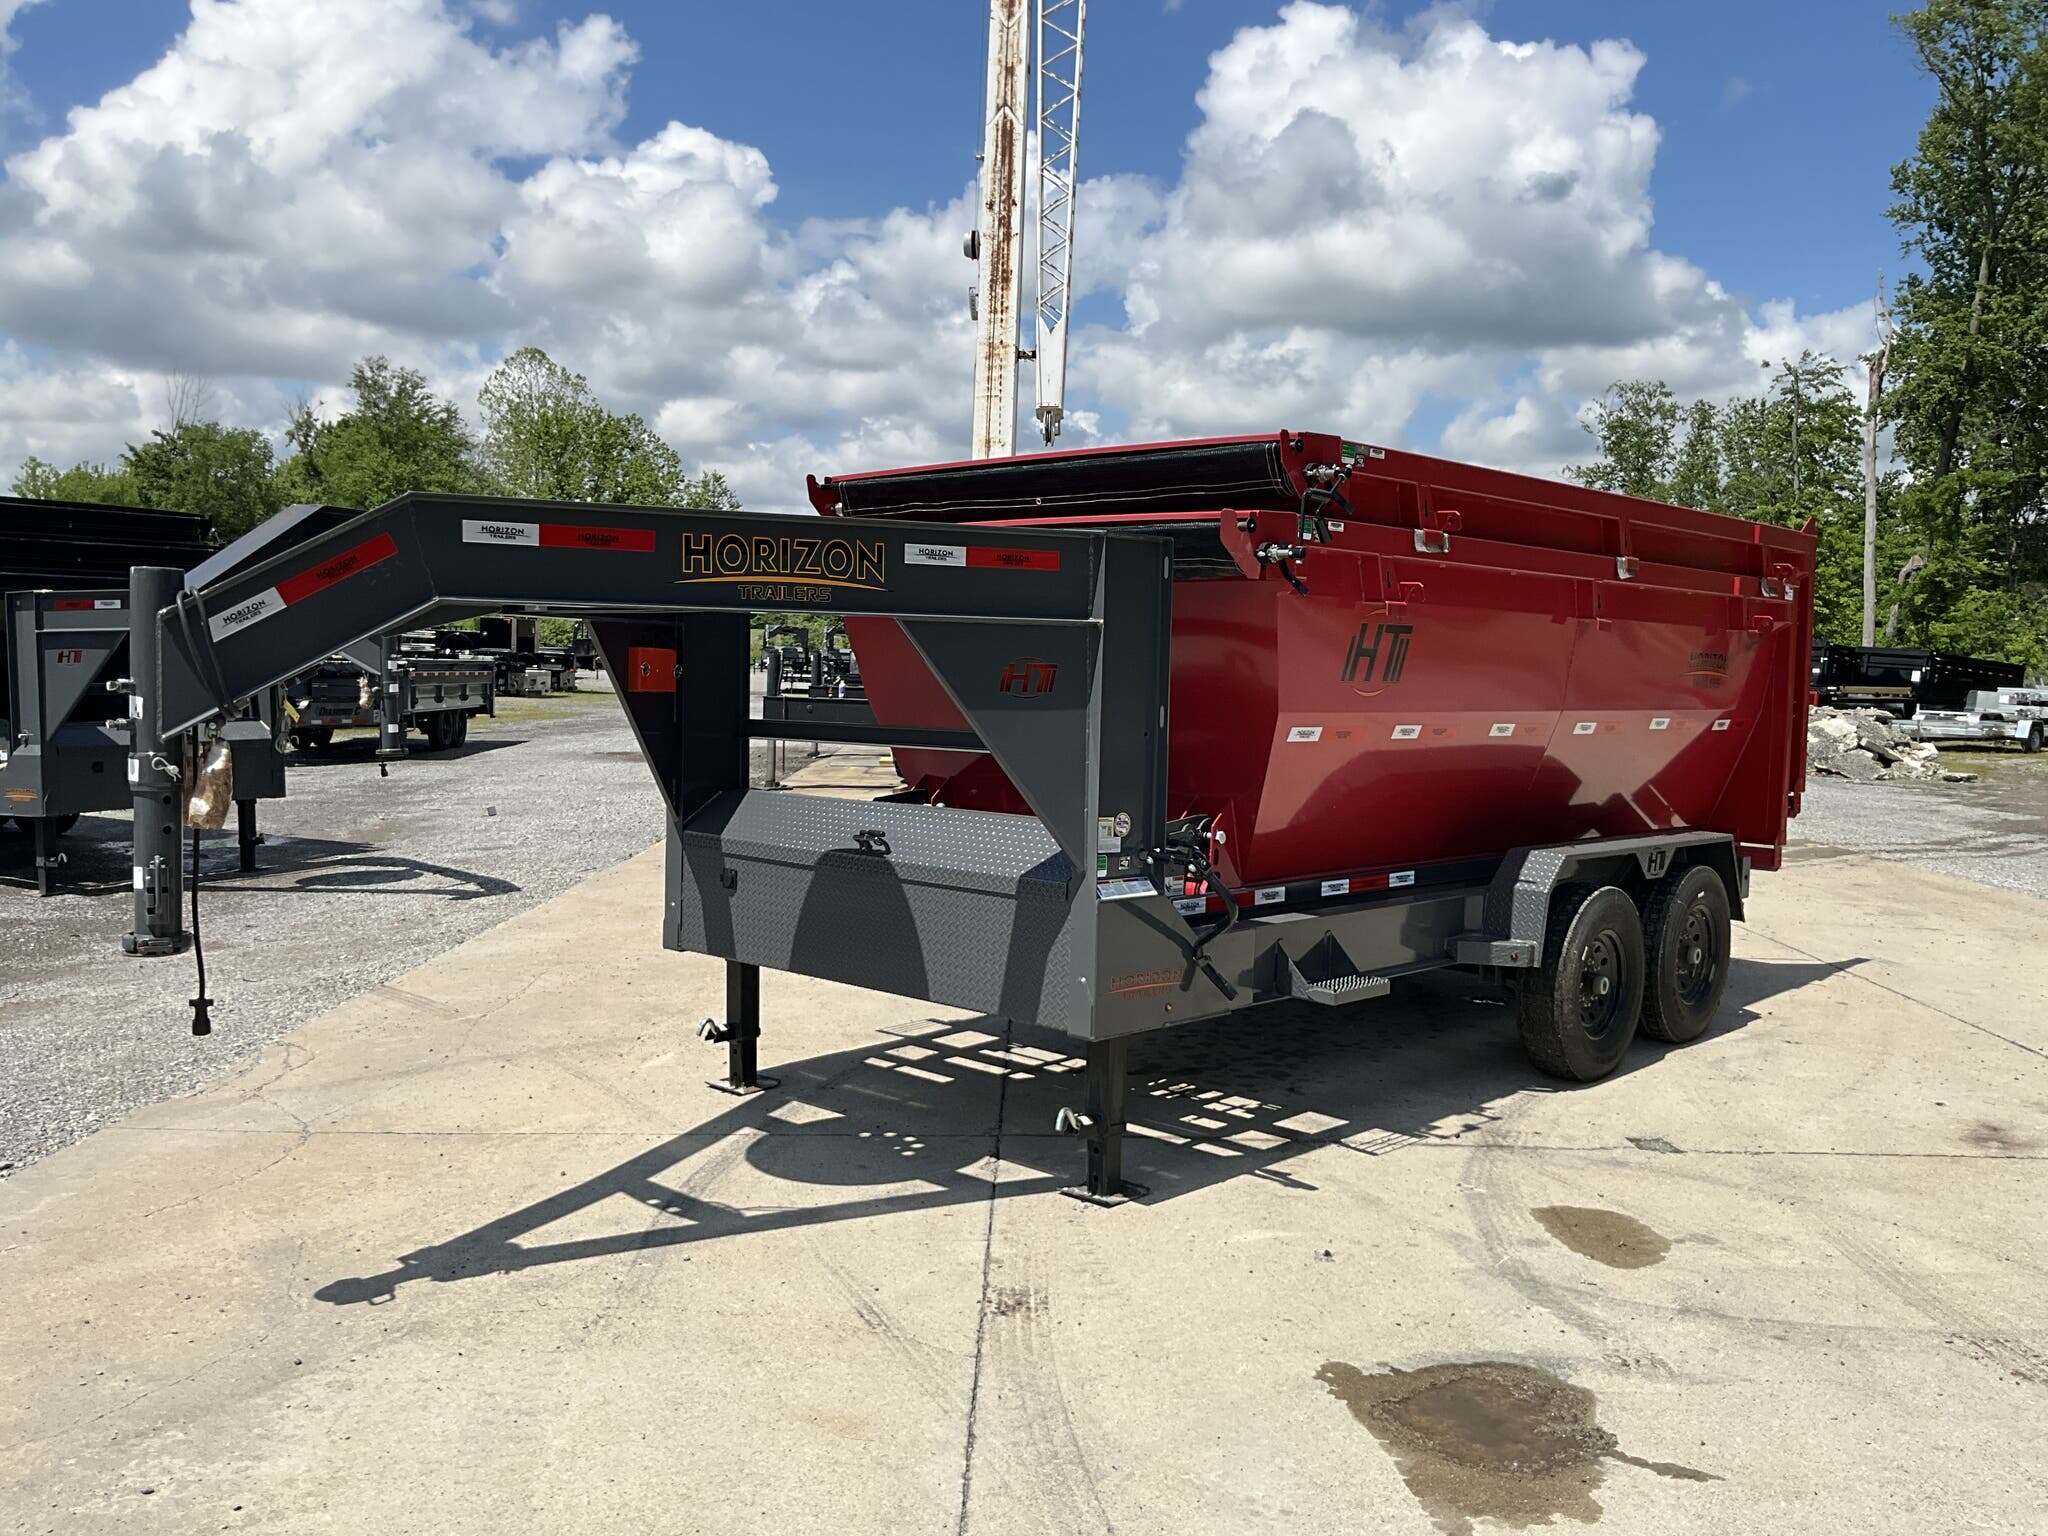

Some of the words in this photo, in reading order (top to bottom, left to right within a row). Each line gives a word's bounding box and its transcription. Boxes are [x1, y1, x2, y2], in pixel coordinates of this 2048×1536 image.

[481, 525, 525, 535] HORIZON
[682, 533, 885, 583] HORIZON
[918, 548, 954, 557] HORIZON
[738, 584, 831, 602] TRAILERS
[222, 599, 266, 624] HORIZON
[1340, 623, 1413, 681] HT
